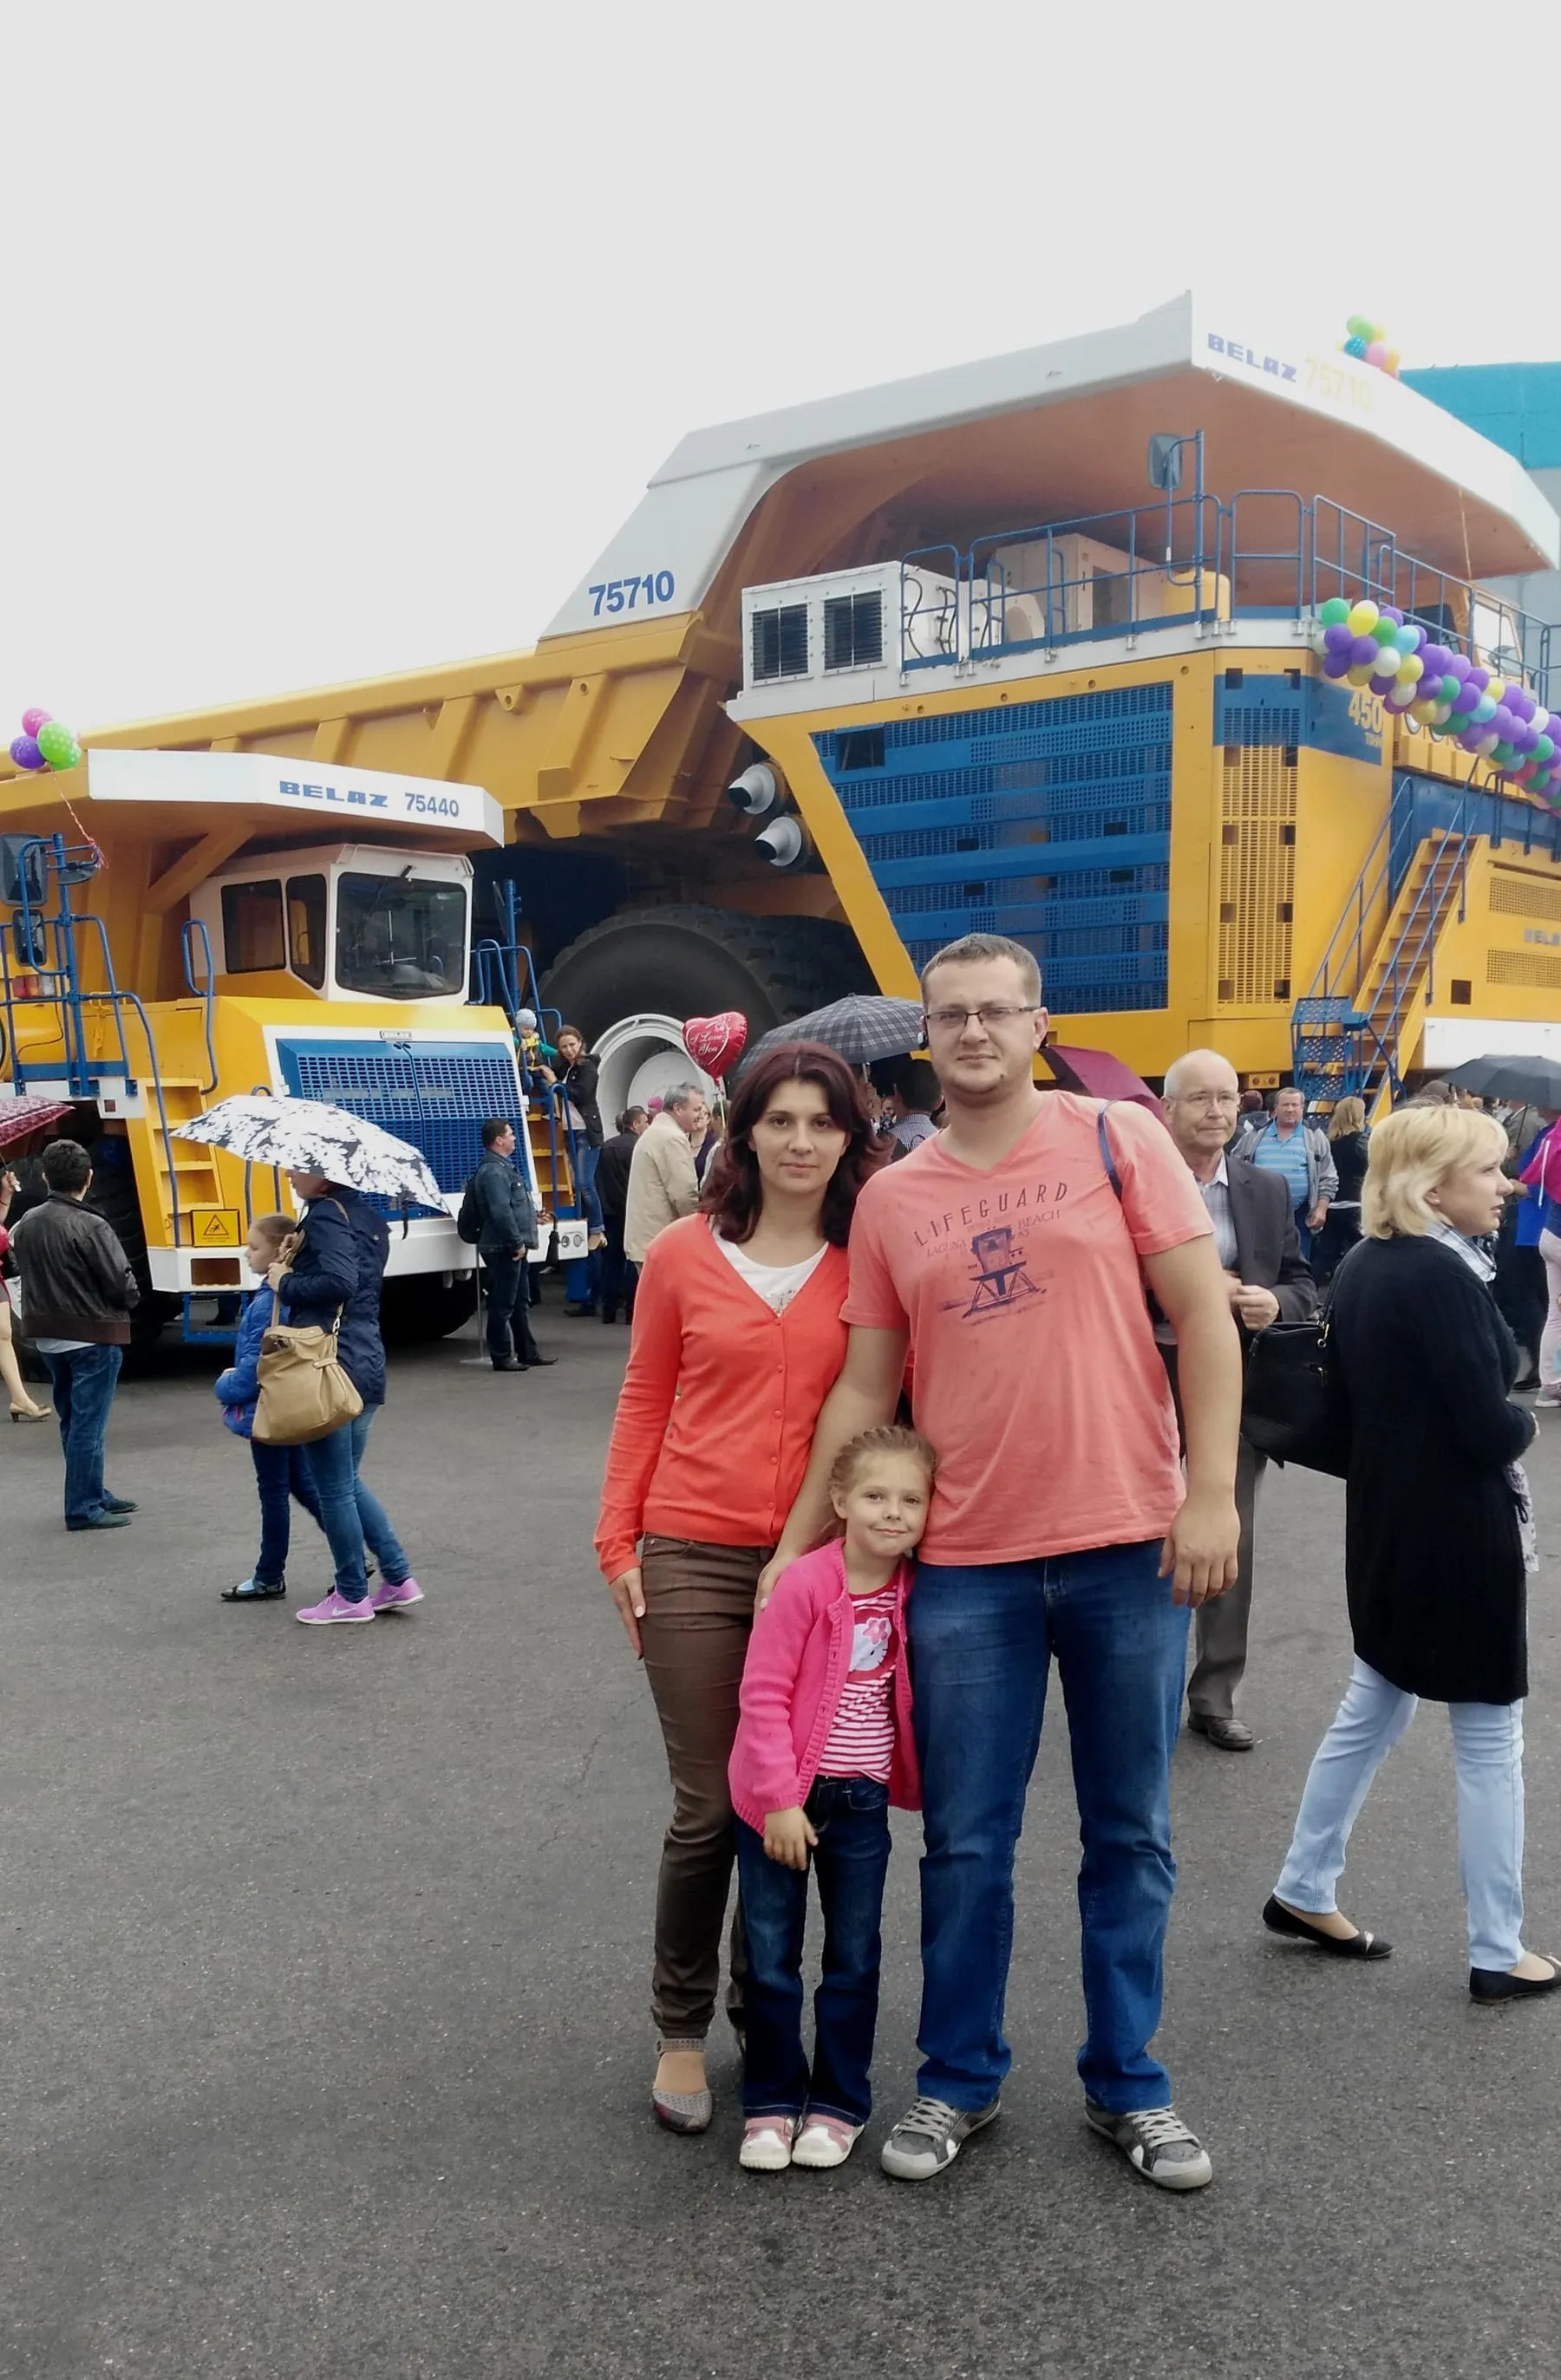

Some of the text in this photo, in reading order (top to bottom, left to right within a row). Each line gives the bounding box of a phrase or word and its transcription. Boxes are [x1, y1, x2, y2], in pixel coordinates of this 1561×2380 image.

[1206, 332, 1373, 414] BELAZ 75710
[588, 570, 676, 616] 75710
[1349, 692, 1383, 734] 450
[279, 780, 460, 818] BELAZ 75440
[698, 1043, 718, 1055] You
[701, 1032, 723, 1042] Love
[913, 1181, 1068, 1247] LIFEGUARD
[1018, 1209, 1061, 1229] BEACH
